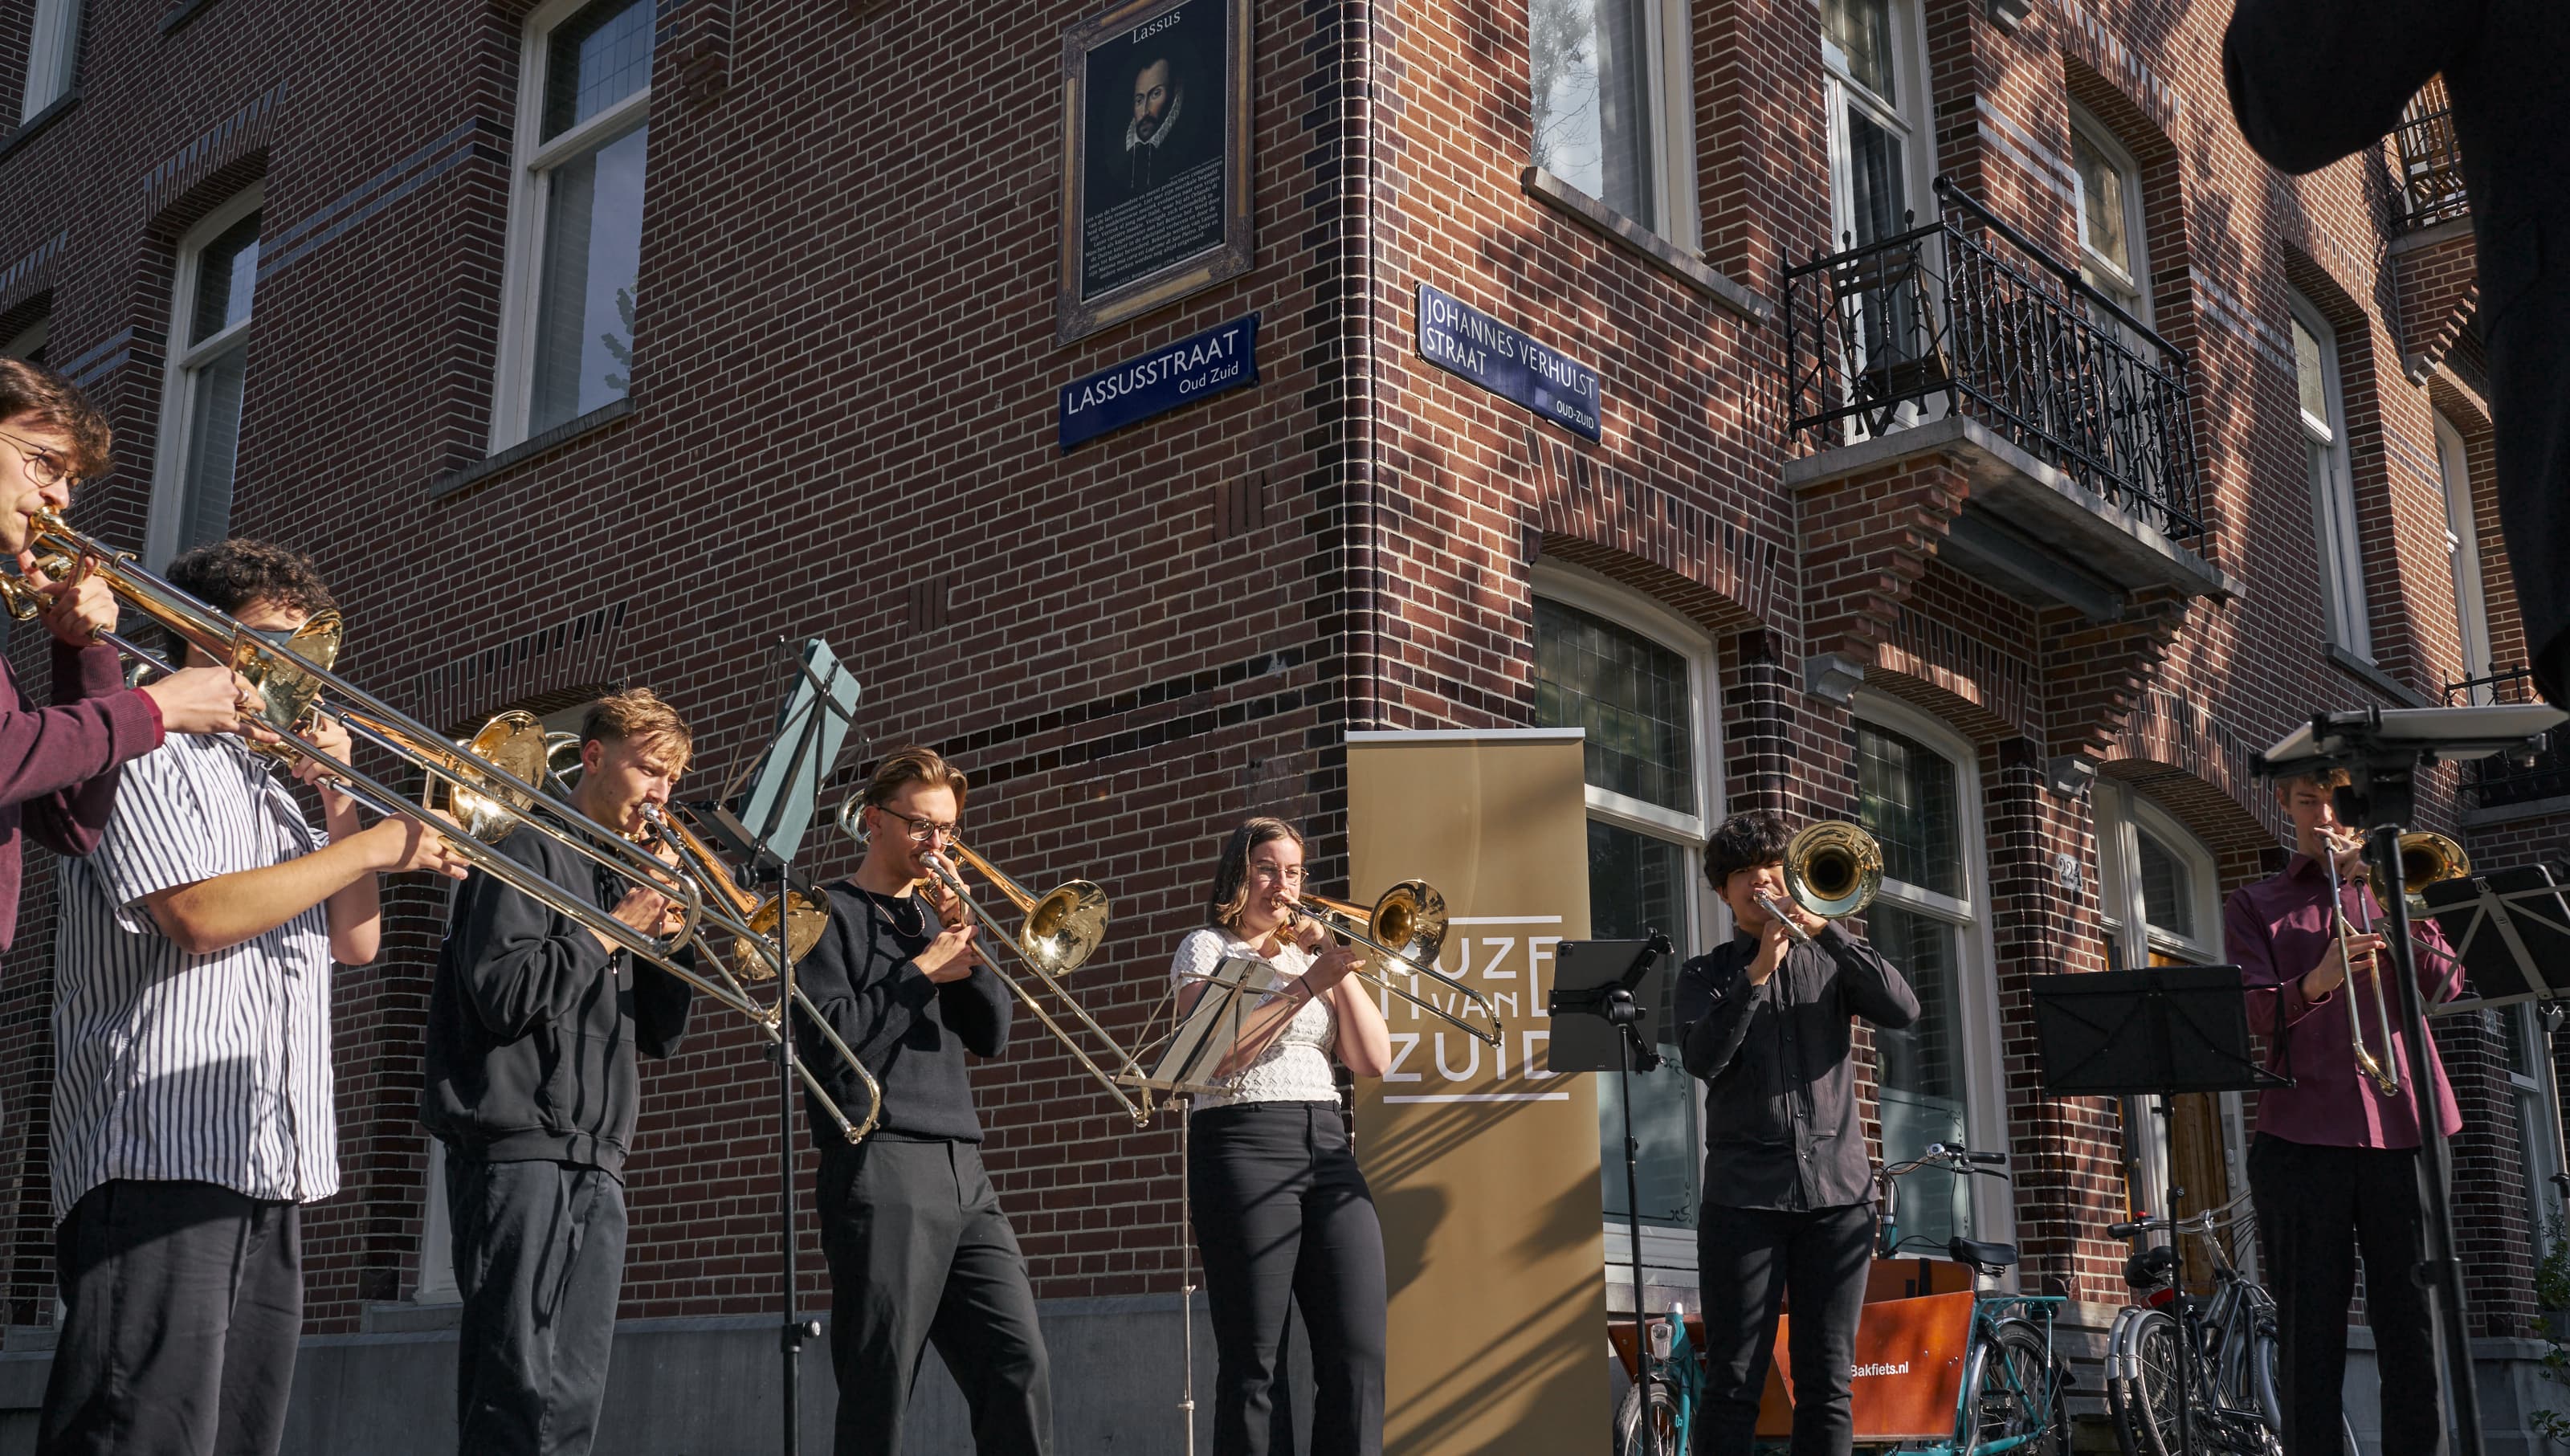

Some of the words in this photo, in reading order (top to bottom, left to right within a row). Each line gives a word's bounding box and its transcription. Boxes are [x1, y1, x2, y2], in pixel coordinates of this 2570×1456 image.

[1133, 11, 1181, 44] Lassus
[1426, 294, 1514, 358] JOHANNES
[1519, 341, 1595, 399] VERHULST
[1426, 327, 1487, 376] STRAAT
[1068, 329, 1239, 415] LASSUSSTRAAT
[1179, 373, 1206, 394] Oud
[1210, 361, 1239, 383] Zuid
[1556, 400, 1594, 430] OUD-ZUID
[1431, 992, 1518, 1019] VAN
[1850, 1361, 1909, 1377] Bakfiets.nl
